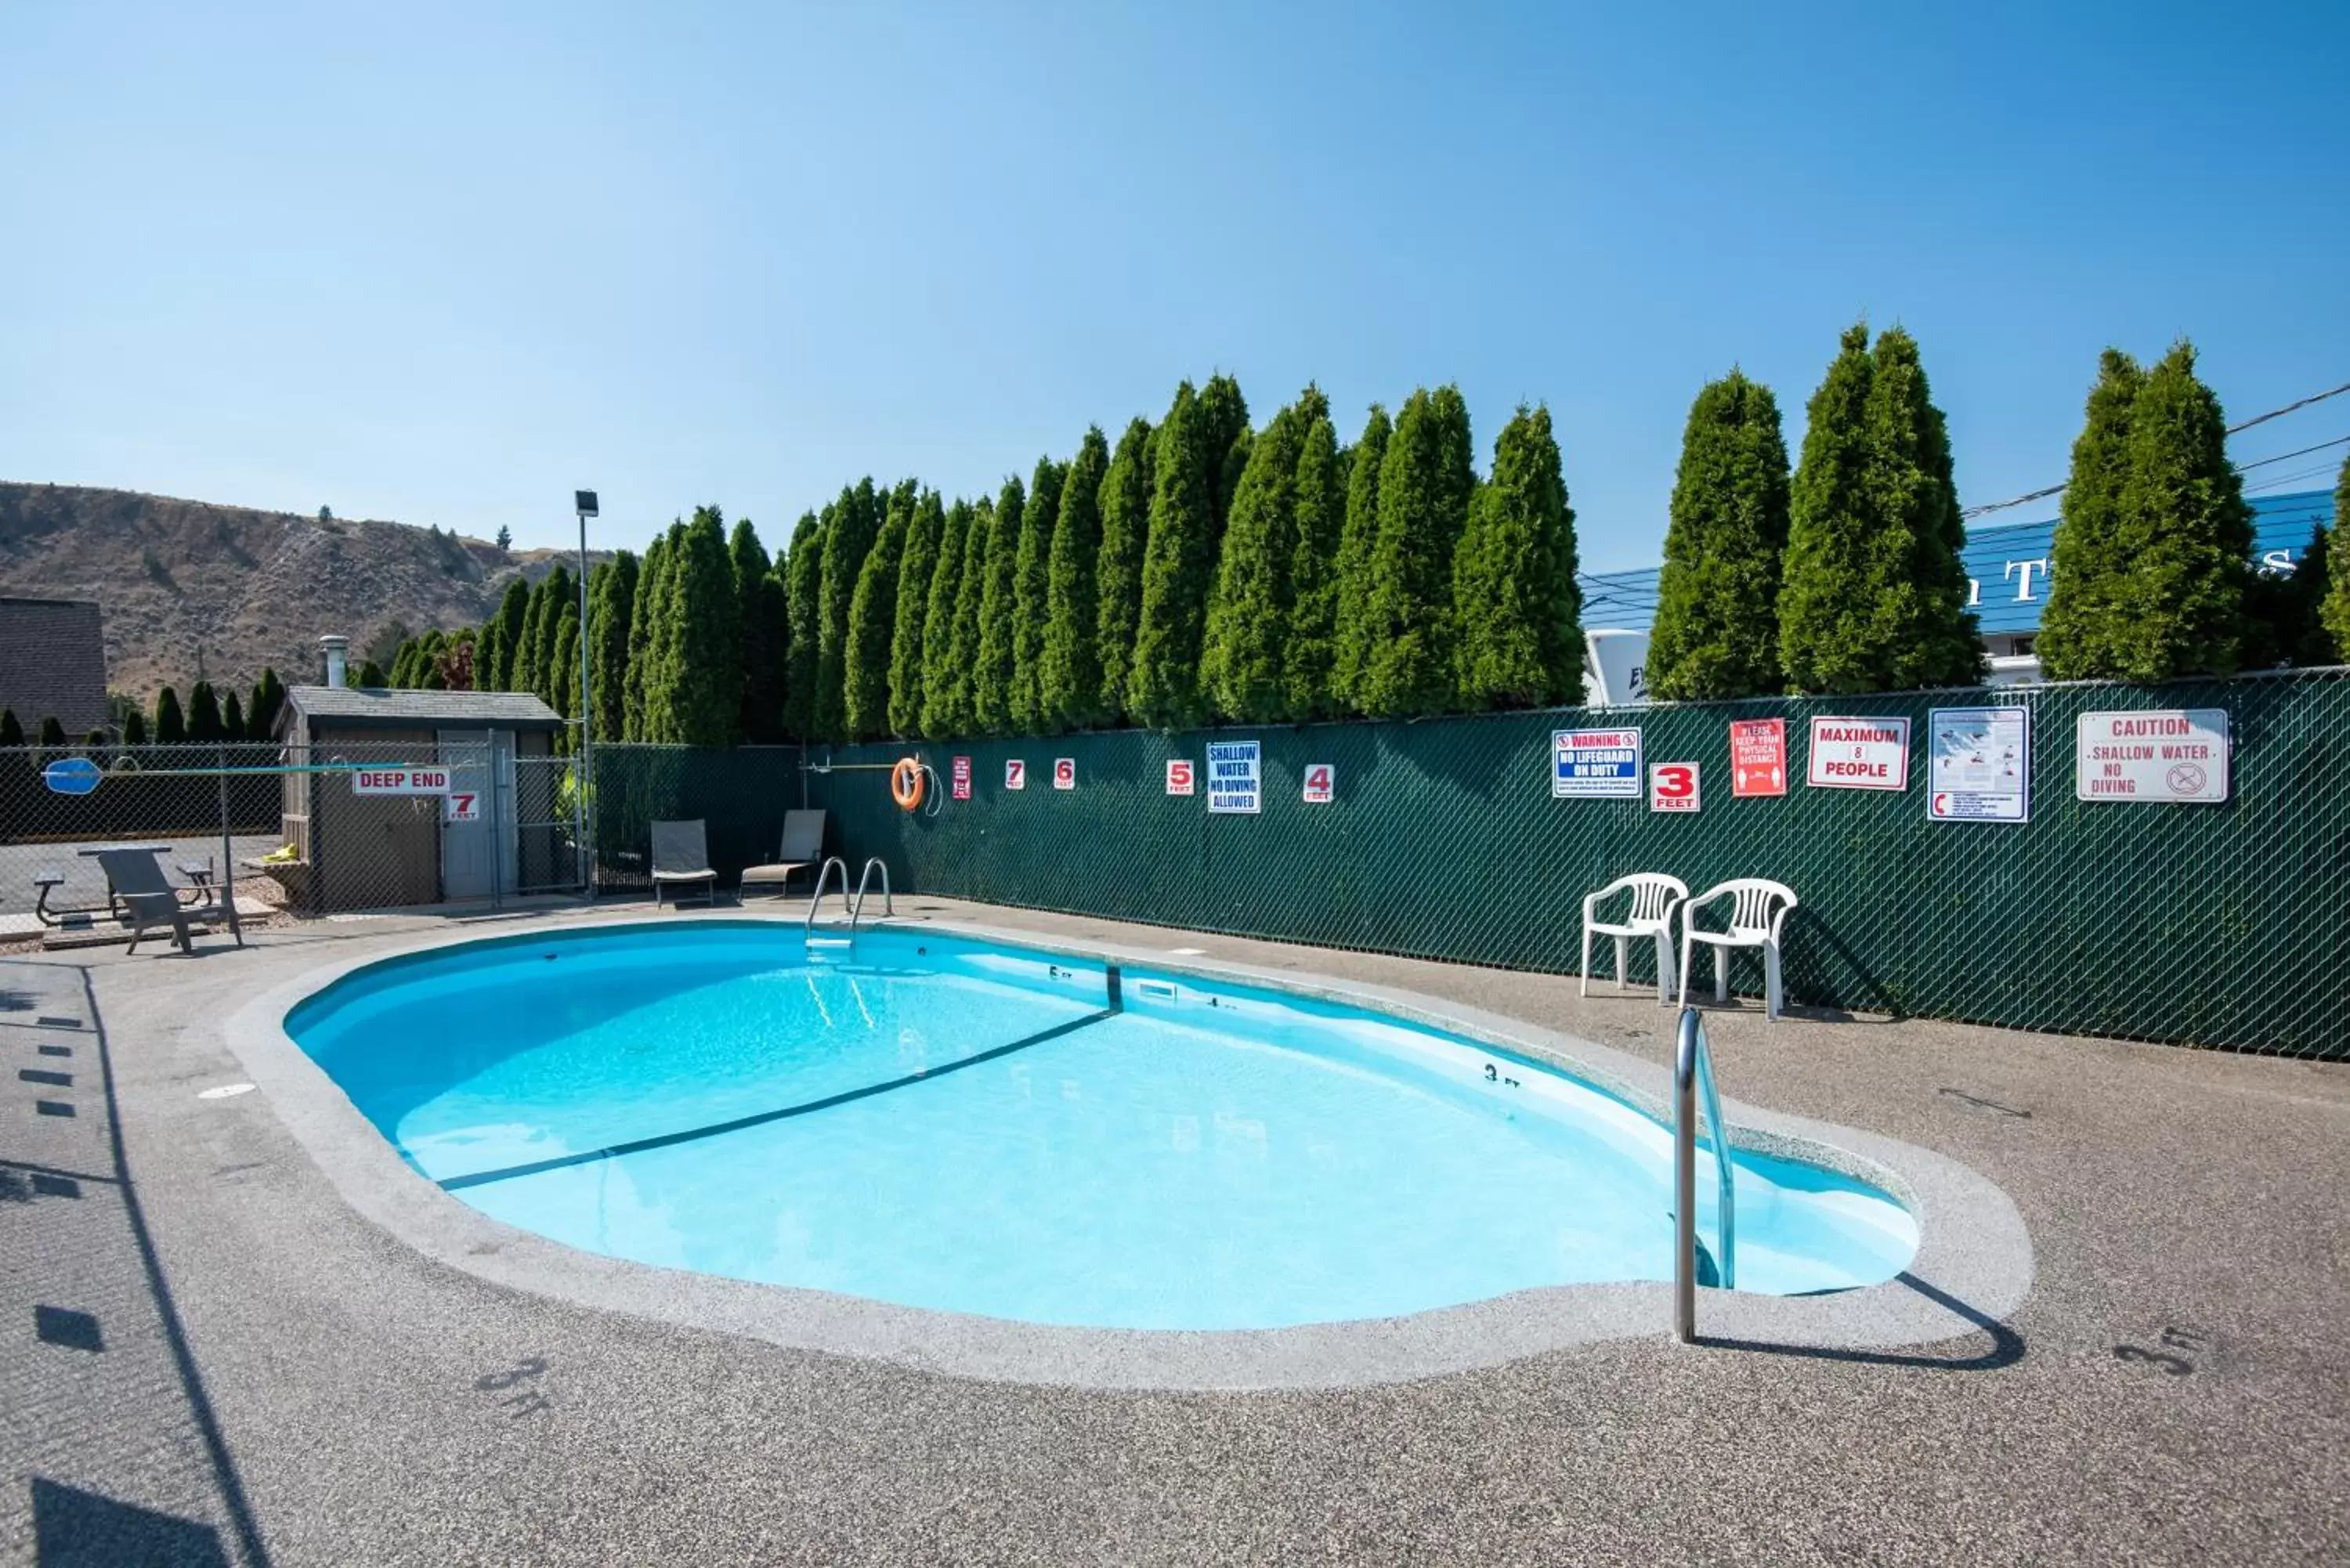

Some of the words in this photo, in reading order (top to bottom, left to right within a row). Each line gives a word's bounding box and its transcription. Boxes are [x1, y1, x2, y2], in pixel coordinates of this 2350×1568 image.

[2112, 718, 2190, 736] CAUTION
[1571, 734, 1621, 747] WARNING
[1820, 728, 1899, 742] MAXIMUM
[1210, 746, 1256, 761] SHALLOW
[1560, 751, 1574, 764] NO
[1576, 750, 1633, 764] LIFEGUARD
[1854, 746, 1862, 758] 8
[2092, 746, 2154, 761] SHALLOW
[2161, 745, 2209, 760] WATER
[1008, 762, 1022, 781] 7
[1057, 761, 1073, 781] 6
[1170, 764, 1191, 786] 5
[1217, 762, 1249, 777] WATER
[1574, 764, 1590, 776] ON
[1592, 764, 1619, 776] DUTY
[1825, 761, 1888, 777] PEOPLE
[2103, 764, 2122, 777] NO
[360, 773, 405, 787] DEEP
[411, 773, 446, 787] END
[1210, 780, 1224, 792] NO
[1224, 779, 1257, 792] DIVING
[1307, 766, 1330, 792] 4
[1656, 767, 1694, 797] 3
[2092, 779, 2135, 793] DIVING
[450, 794, 475, 812] 7
[1213, 795, 1254, 808] ALLOWED
[1657, 798, 1694, 807] FEET
